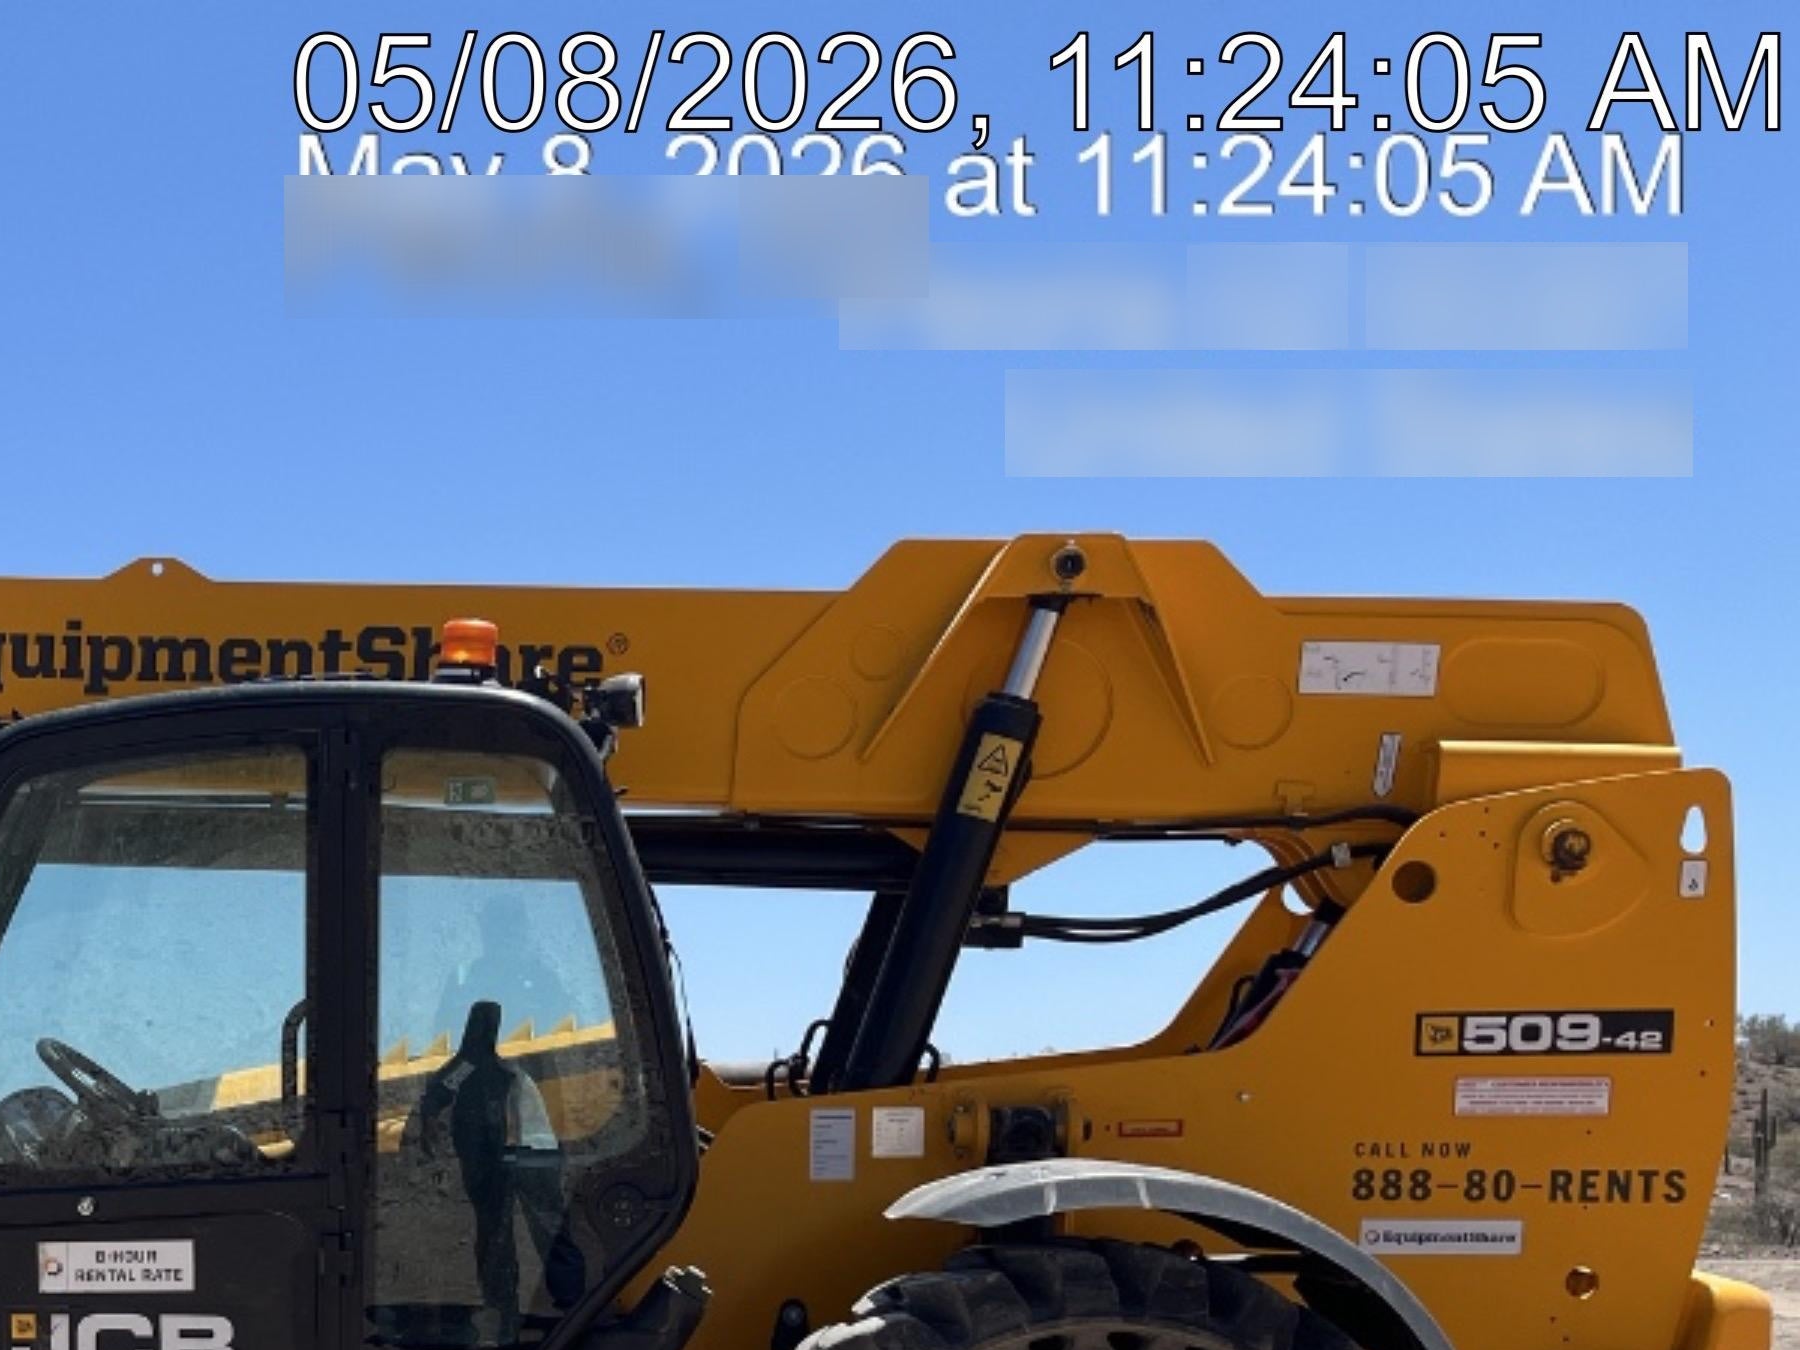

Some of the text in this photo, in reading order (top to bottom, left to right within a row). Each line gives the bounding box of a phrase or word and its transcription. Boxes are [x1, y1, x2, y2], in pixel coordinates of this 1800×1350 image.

[1463, 1013, 1663, 1052] 509-42
[1355, 1142, 1472, 1159] CALL NOW
[1352, 1168, 1687, 1204] 888-80-RENTS
[74, 1268, 184, 1282] RENTAL RATE
